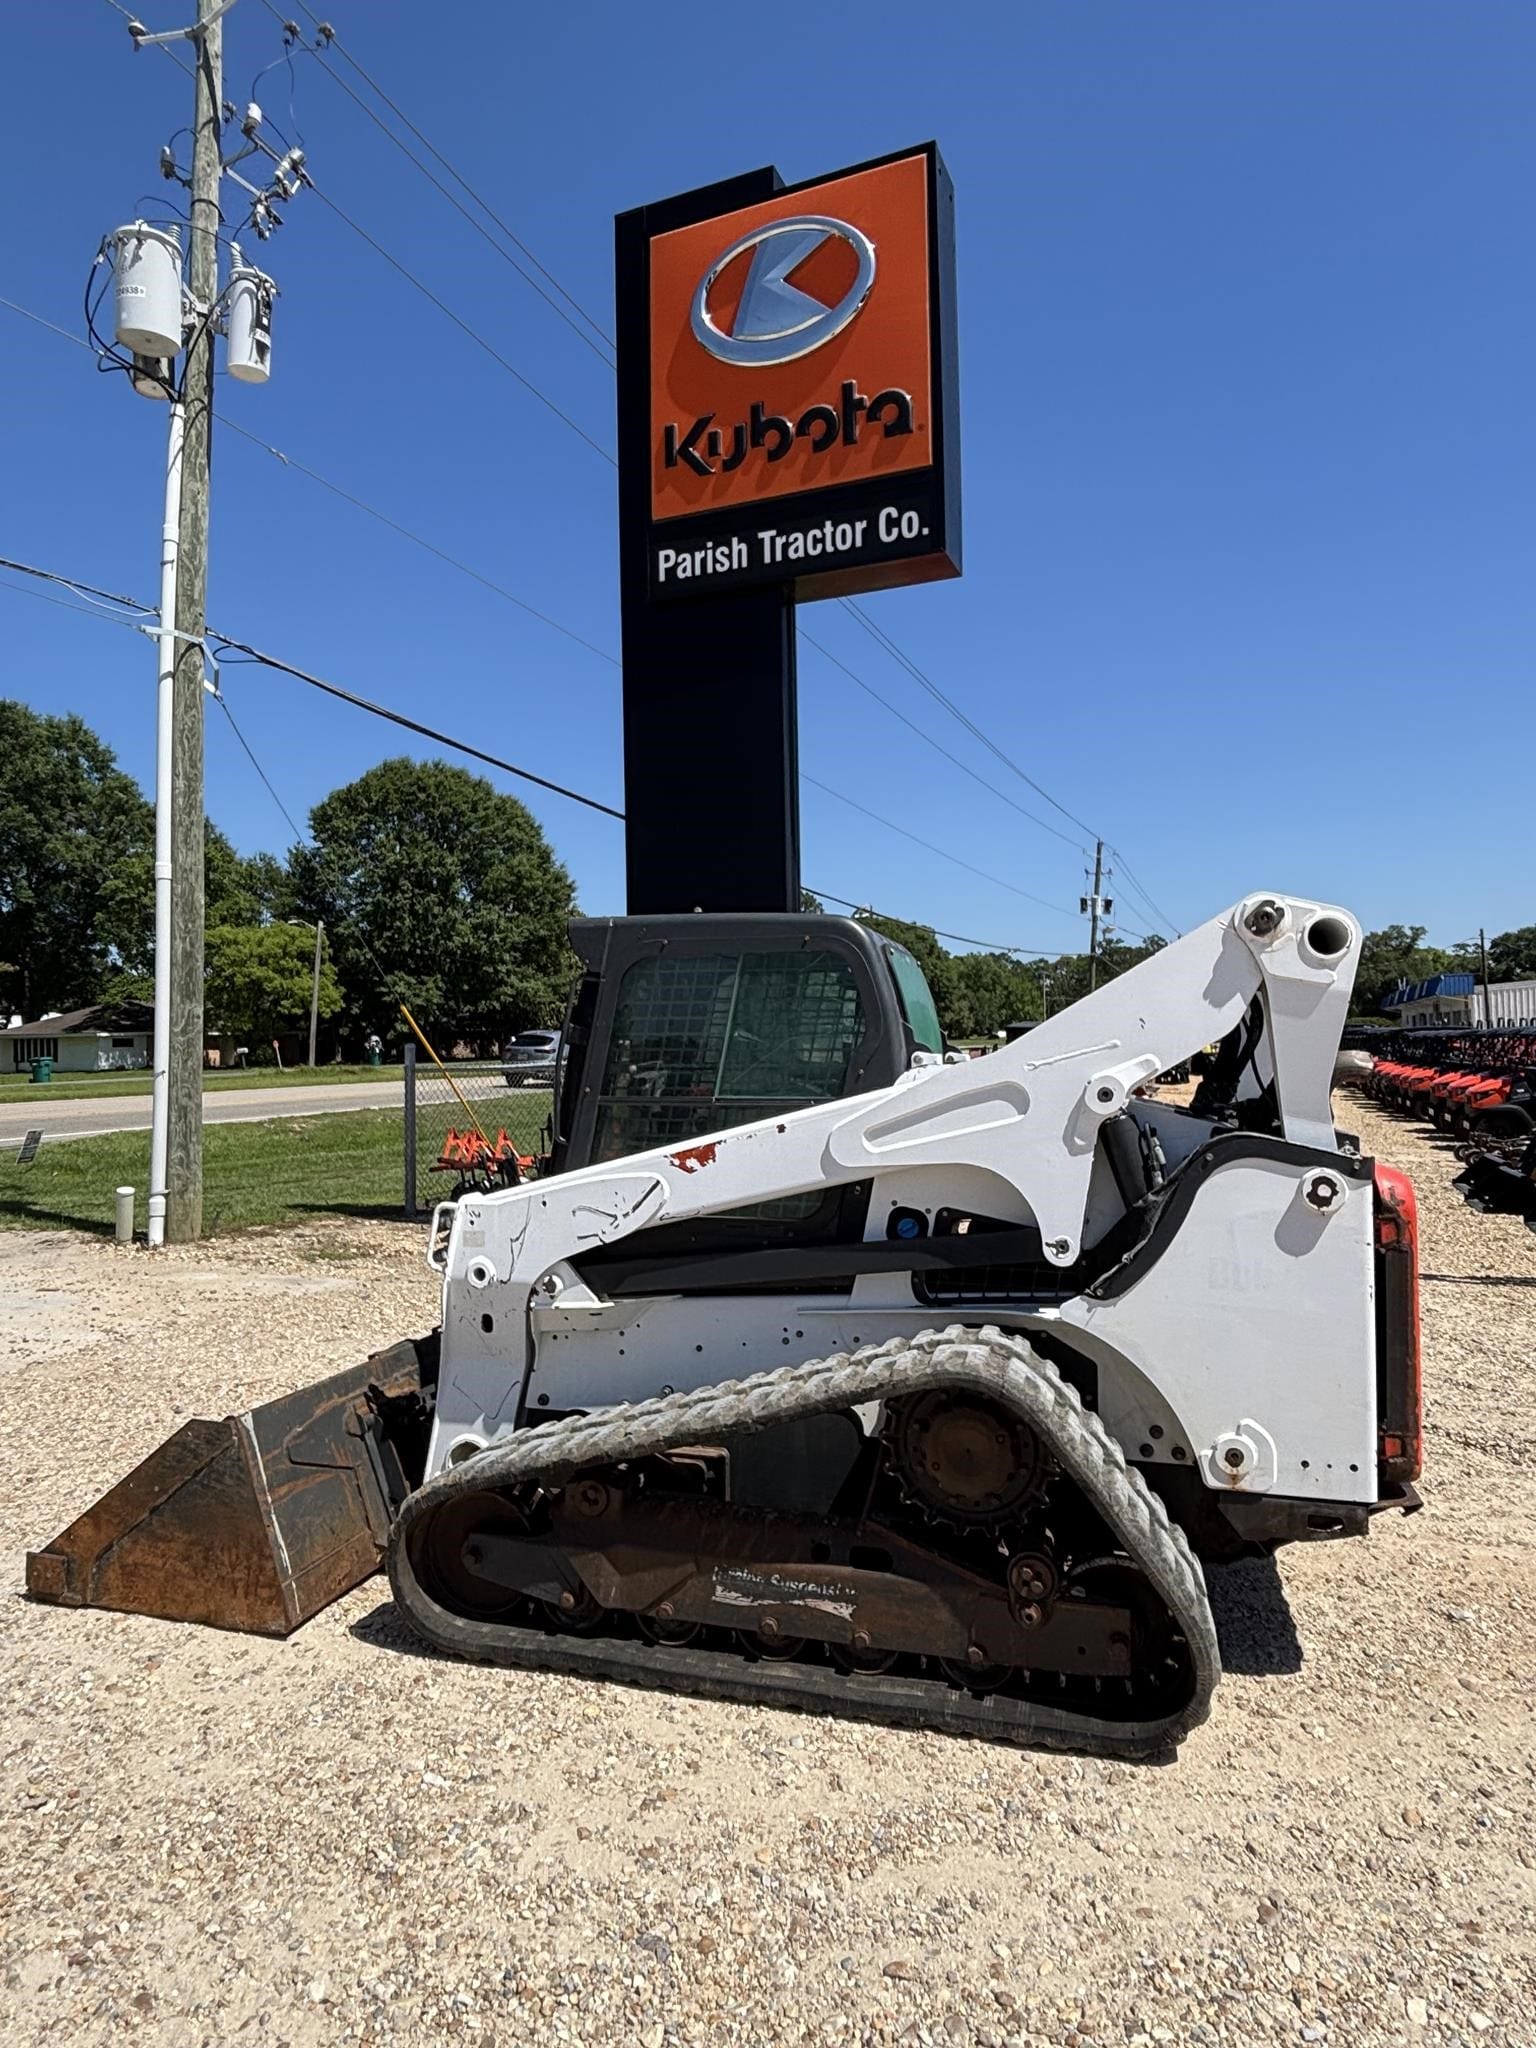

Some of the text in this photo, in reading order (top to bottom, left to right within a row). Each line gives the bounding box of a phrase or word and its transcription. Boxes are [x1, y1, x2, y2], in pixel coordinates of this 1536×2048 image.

[664, 379, 915, 477] Kubota
[658, 506, 930, 582] Parish Tractor Co.
